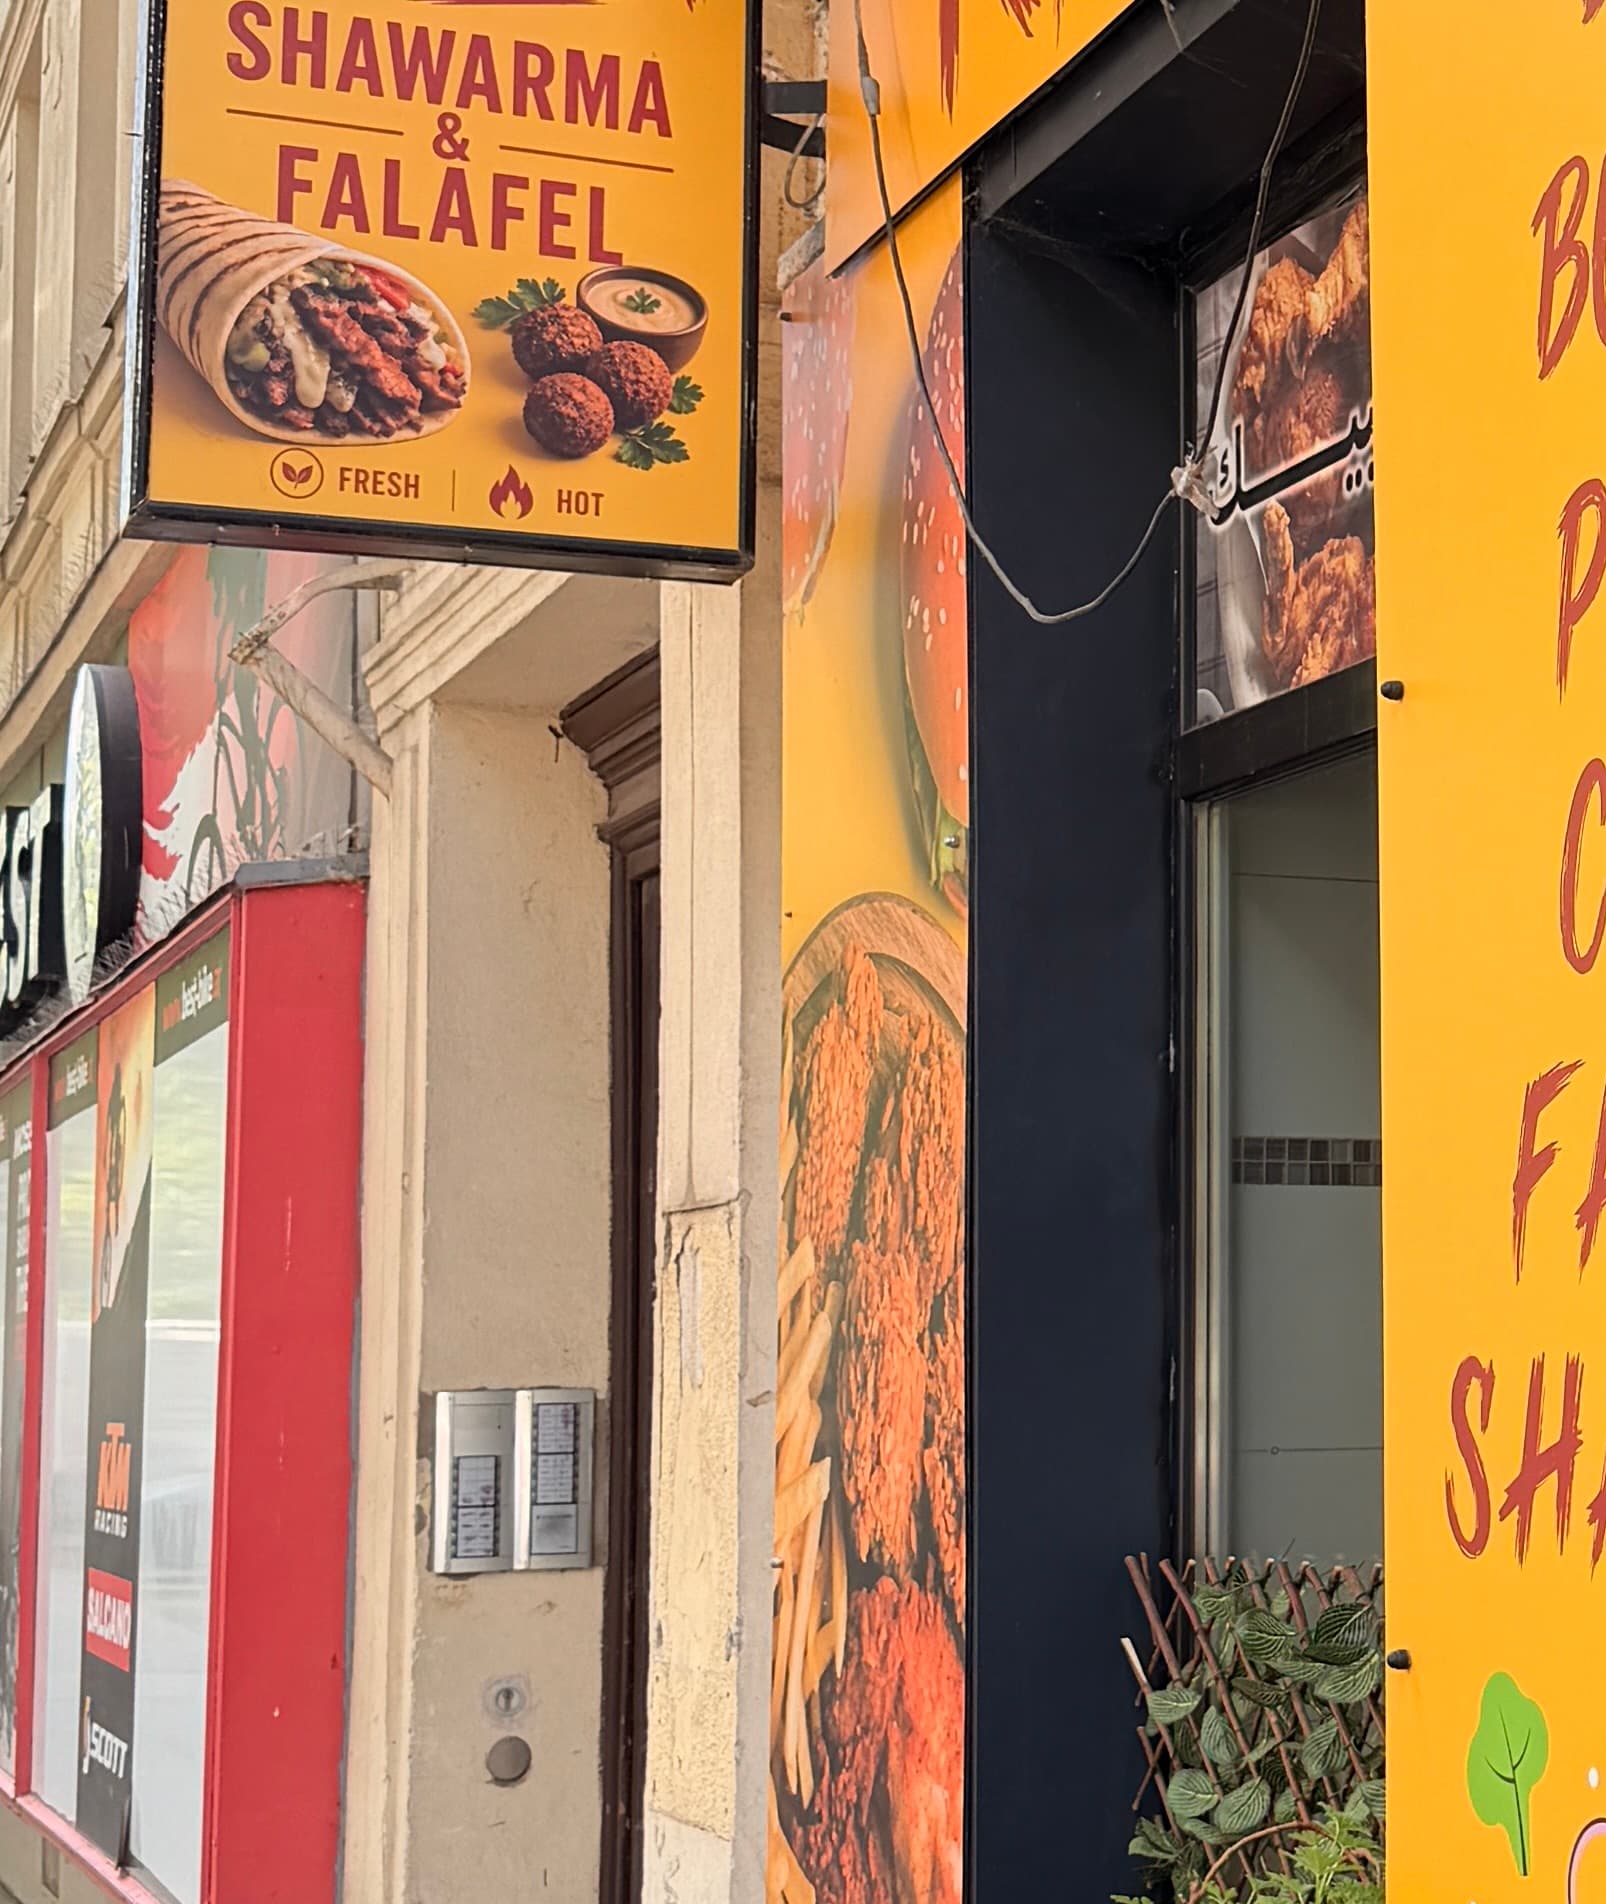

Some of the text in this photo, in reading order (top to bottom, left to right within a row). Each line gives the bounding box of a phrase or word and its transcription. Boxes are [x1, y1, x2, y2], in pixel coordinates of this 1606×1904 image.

[226, 0, 674, 139] SHAWARMA
[432, 111, 471, 162] &
[276, 143, 624, 266] FALAFEL
[338, 465, 421, 500] FRESH
[556, 487, 606, 518] HOT
[97, 1422, 131, 1513] KTM
[90, 1720, 128, 1780] SCOTT
